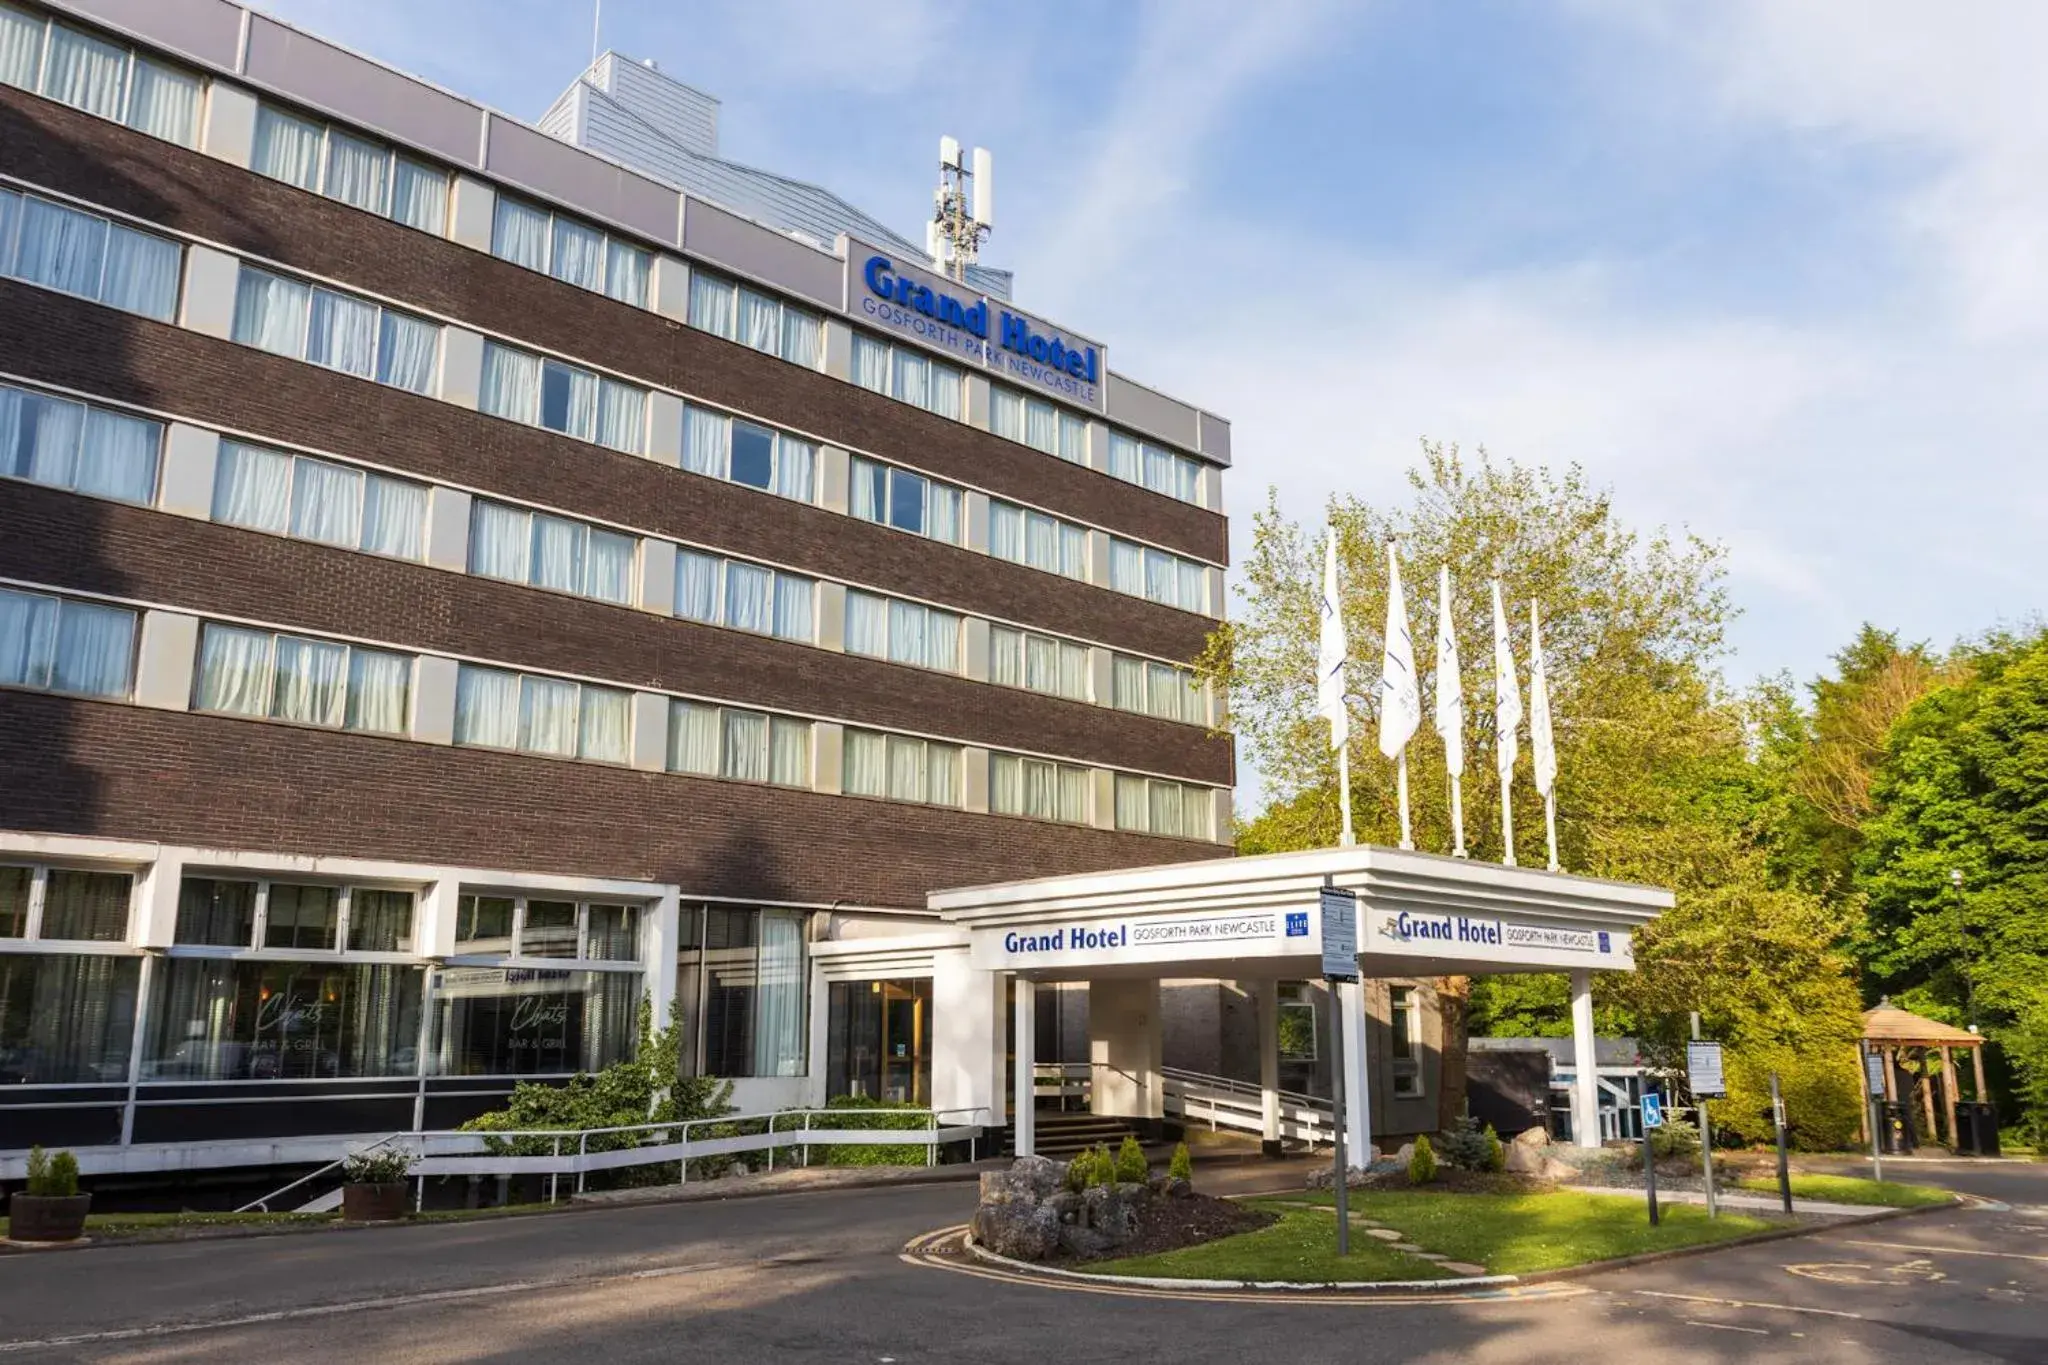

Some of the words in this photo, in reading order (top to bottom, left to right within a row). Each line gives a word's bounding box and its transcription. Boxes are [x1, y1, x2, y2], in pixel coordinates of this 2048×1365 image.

[864, 256, 987, 340] Grand
[1000, 310, 1096, 384] Hotel
[863, 297, 958, 347] GOSFORTH
[966, 338, 1003, 365] PARK
[1009, 358, 1094, 402] NEWCASTLE
[1005, 932, 1063, 953] Grand
[1071, 924, 1126, 949] Hotel
[1133, 926, 1186, 940] GOSFORTH
[1189, 924, 1212, 936] PARK
[1215, 920, 1275, 934] NEWCASTLE
[1398, 911, 1452, 940] Grand
[1458, 916, 1502, 944] Hotel
